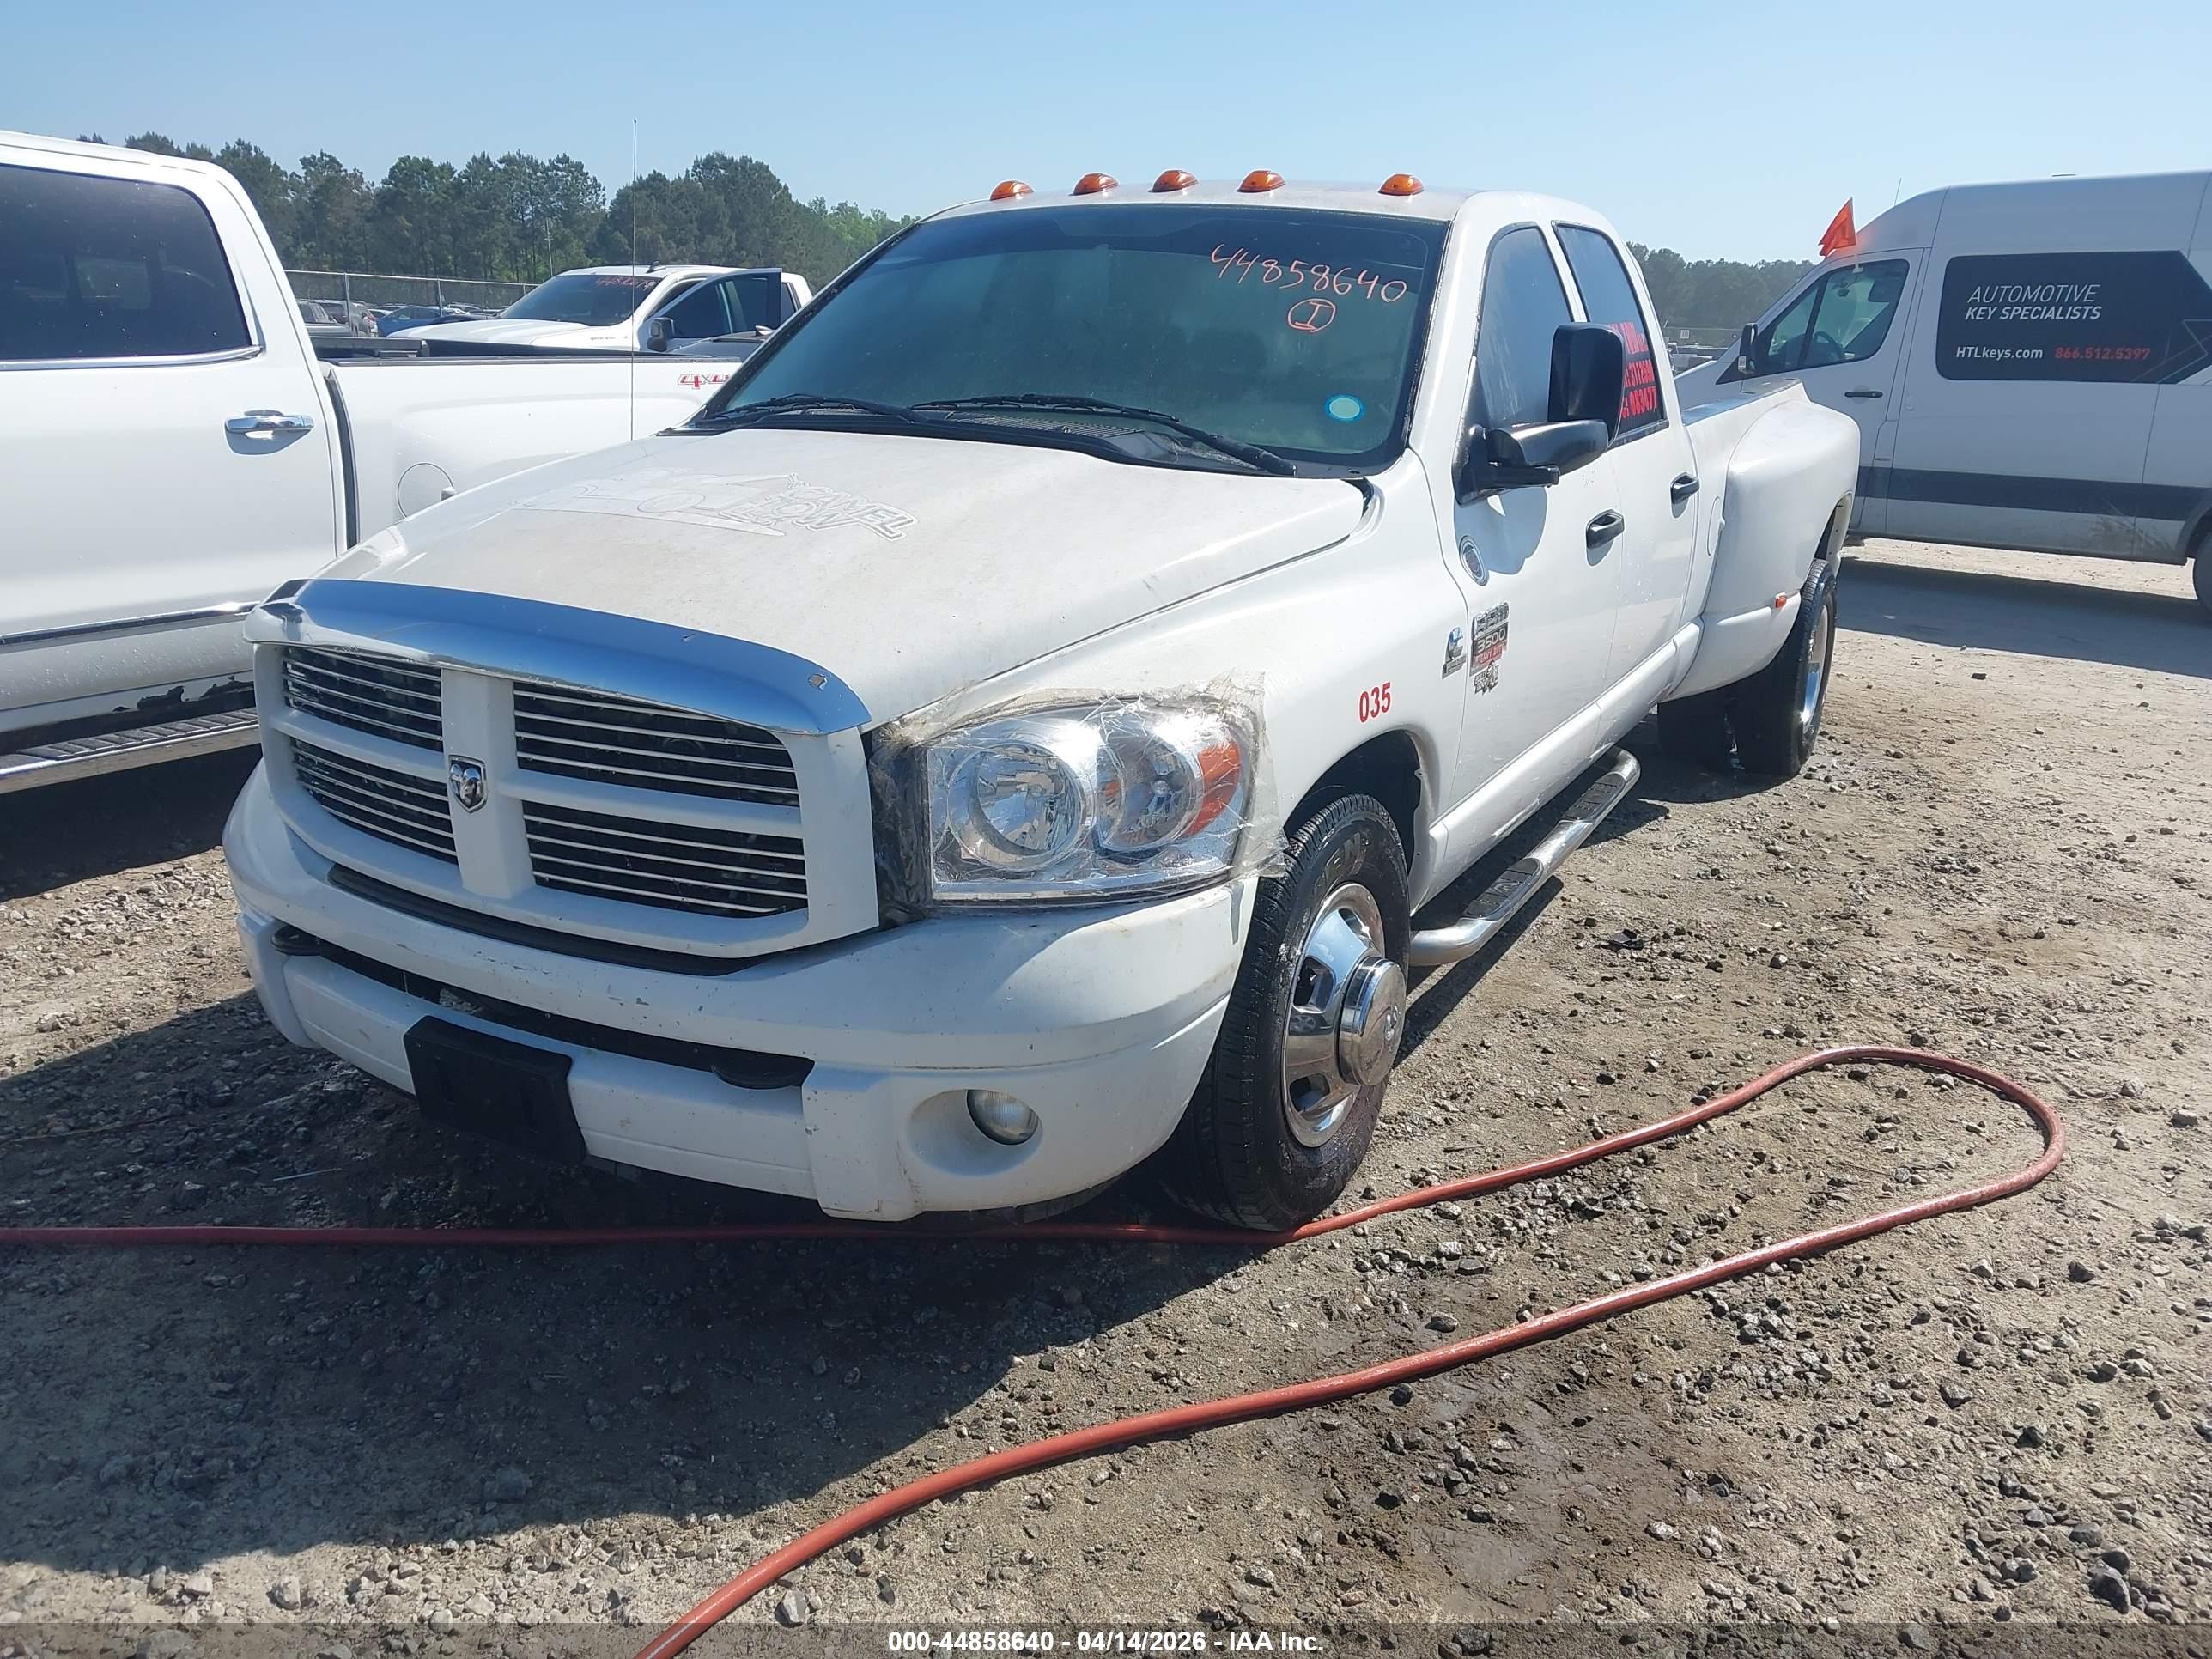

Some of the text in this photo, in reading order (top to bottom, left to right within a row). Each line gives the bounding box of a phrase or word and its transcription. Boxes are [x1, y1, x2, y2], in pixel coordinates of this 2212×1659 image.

[1211, 244, 1407, 303] 44858640
[1967, 284, 2101, 303] AUTOMOTIVE
[1965, 306, 2102, 319] KEY SPECIALISTS
[1956, 346, 2150, 361] HTLkeys.com 866.512.5397
[1476, 628, 1506, 653] 3500
[1359, 681, 1391, 722] 035
